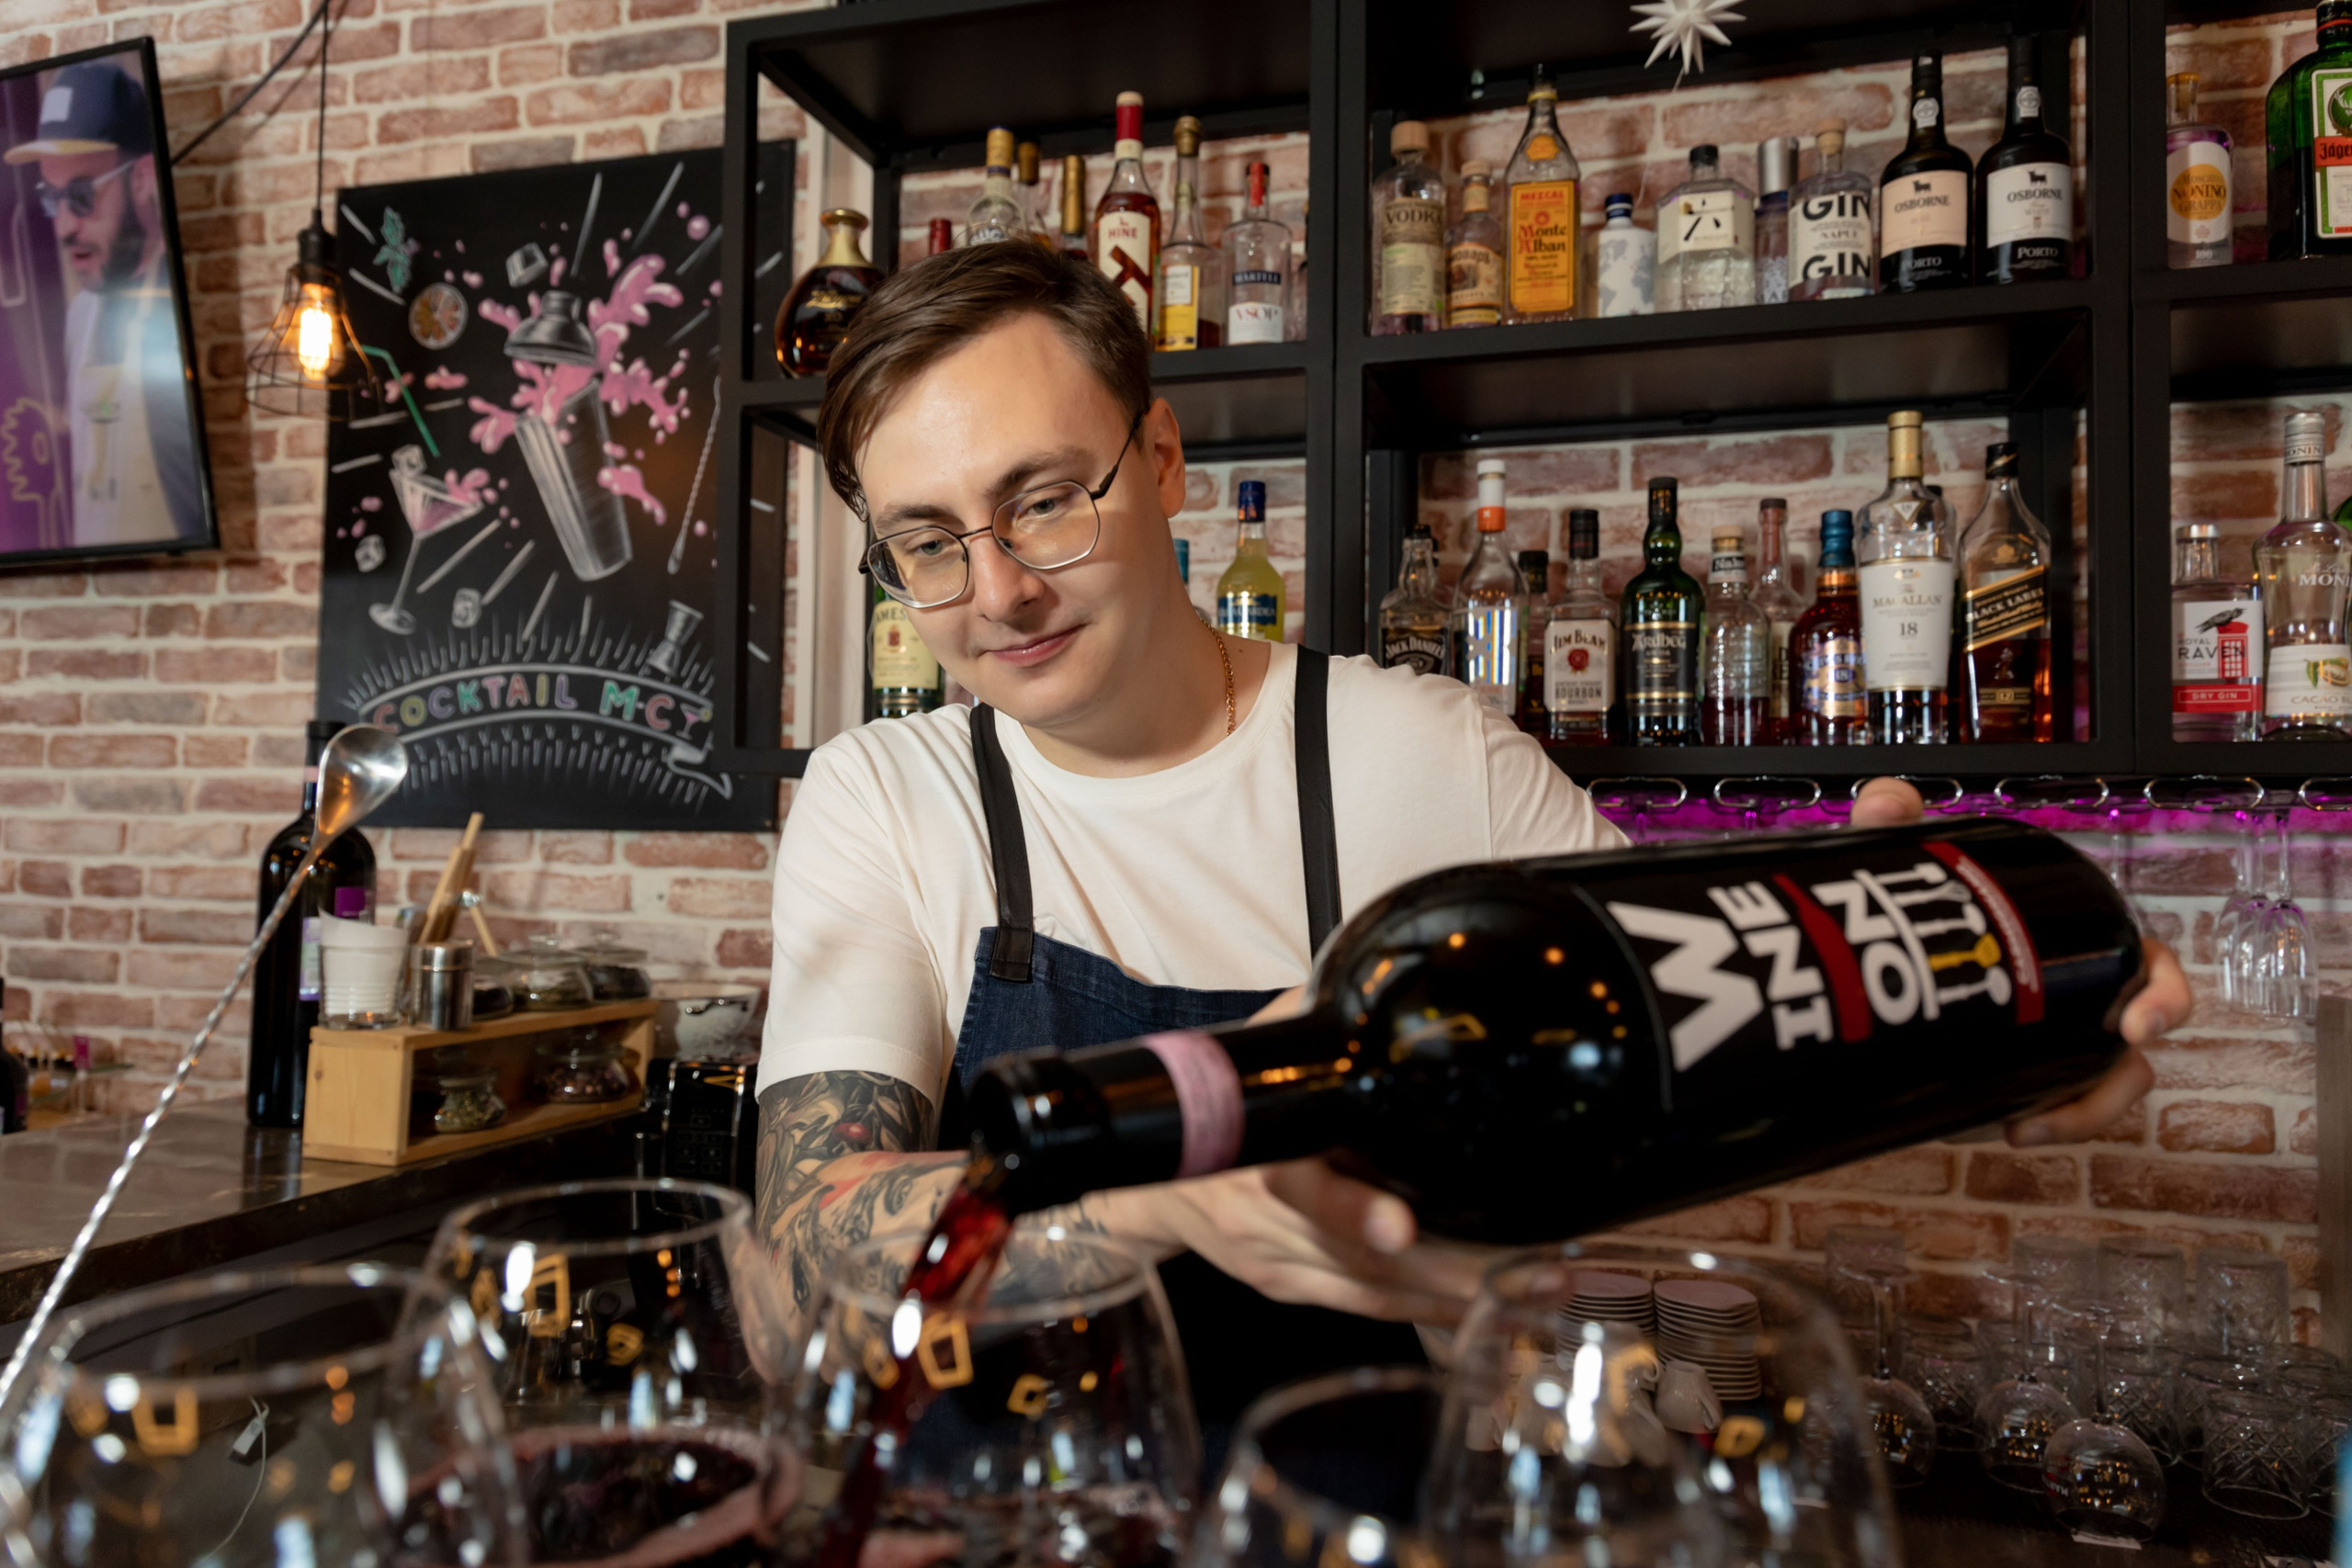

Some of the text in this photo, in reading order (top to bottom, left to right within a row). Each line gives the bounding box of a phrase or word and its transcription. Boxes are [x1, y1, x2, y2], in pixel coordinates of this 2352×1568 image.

[2007, 188, 2064, 203] OSBORNE
[2173, 184, 2227, 199] NONINO
[1803, 195, 1871, 220] GIN
[1894, 196, 1950, 213] OSBORNE
[1108, 227, 1137, 240] HINE
[1518, 238, 1566, 254] Alban
[2017, 246, 2060, 260] PORTO
[1803, 252, 1871, 280] GIN
[1872, 595, 1942, 609] MACALLAN
[1965, 601, 2006, 623] BLACK
[2006, 586, 2045, 608] LABEL
[1899, 622, 1918, 637] 18
[1550, 635, 1572, 655] JIM
[1632, 631, 1687, 652] Ardbeg
[2178, 645, 2245, 660] RAVEN
[1555, 686, 1602, 699] BOURBON
[2192, 692, 2237, 700] DRY GIN
[2290, 695, 2339, 704] CACAO
[373, 673, 578, 734] COCKTAIL
